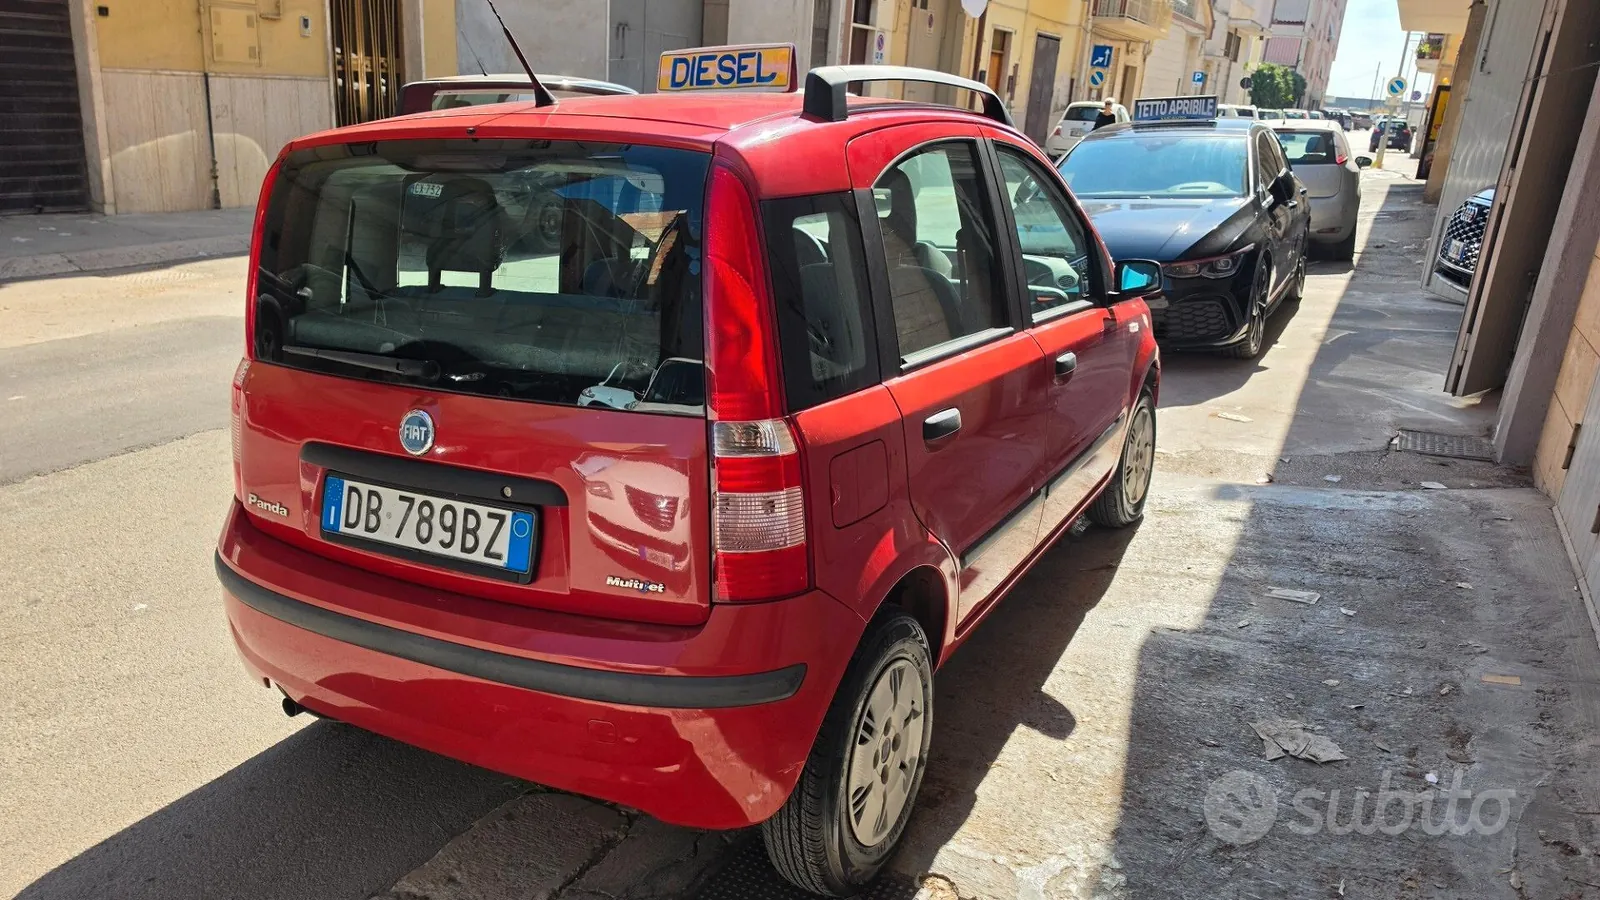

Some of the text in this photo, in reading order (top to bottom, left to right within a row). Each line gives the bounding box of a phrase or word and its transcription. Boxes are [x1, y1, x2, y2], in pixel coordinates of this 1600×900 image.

[670, 52, 777, 88] DIESEL
[1137, 99, 1214, 118] TETTO APRIBILE
[404, 424, 427, 441] FIAT
[248, 493, 290, 518] Panda
[344, 485, 383, 533] DB
[394, 494, 507, 561] 789BZ
